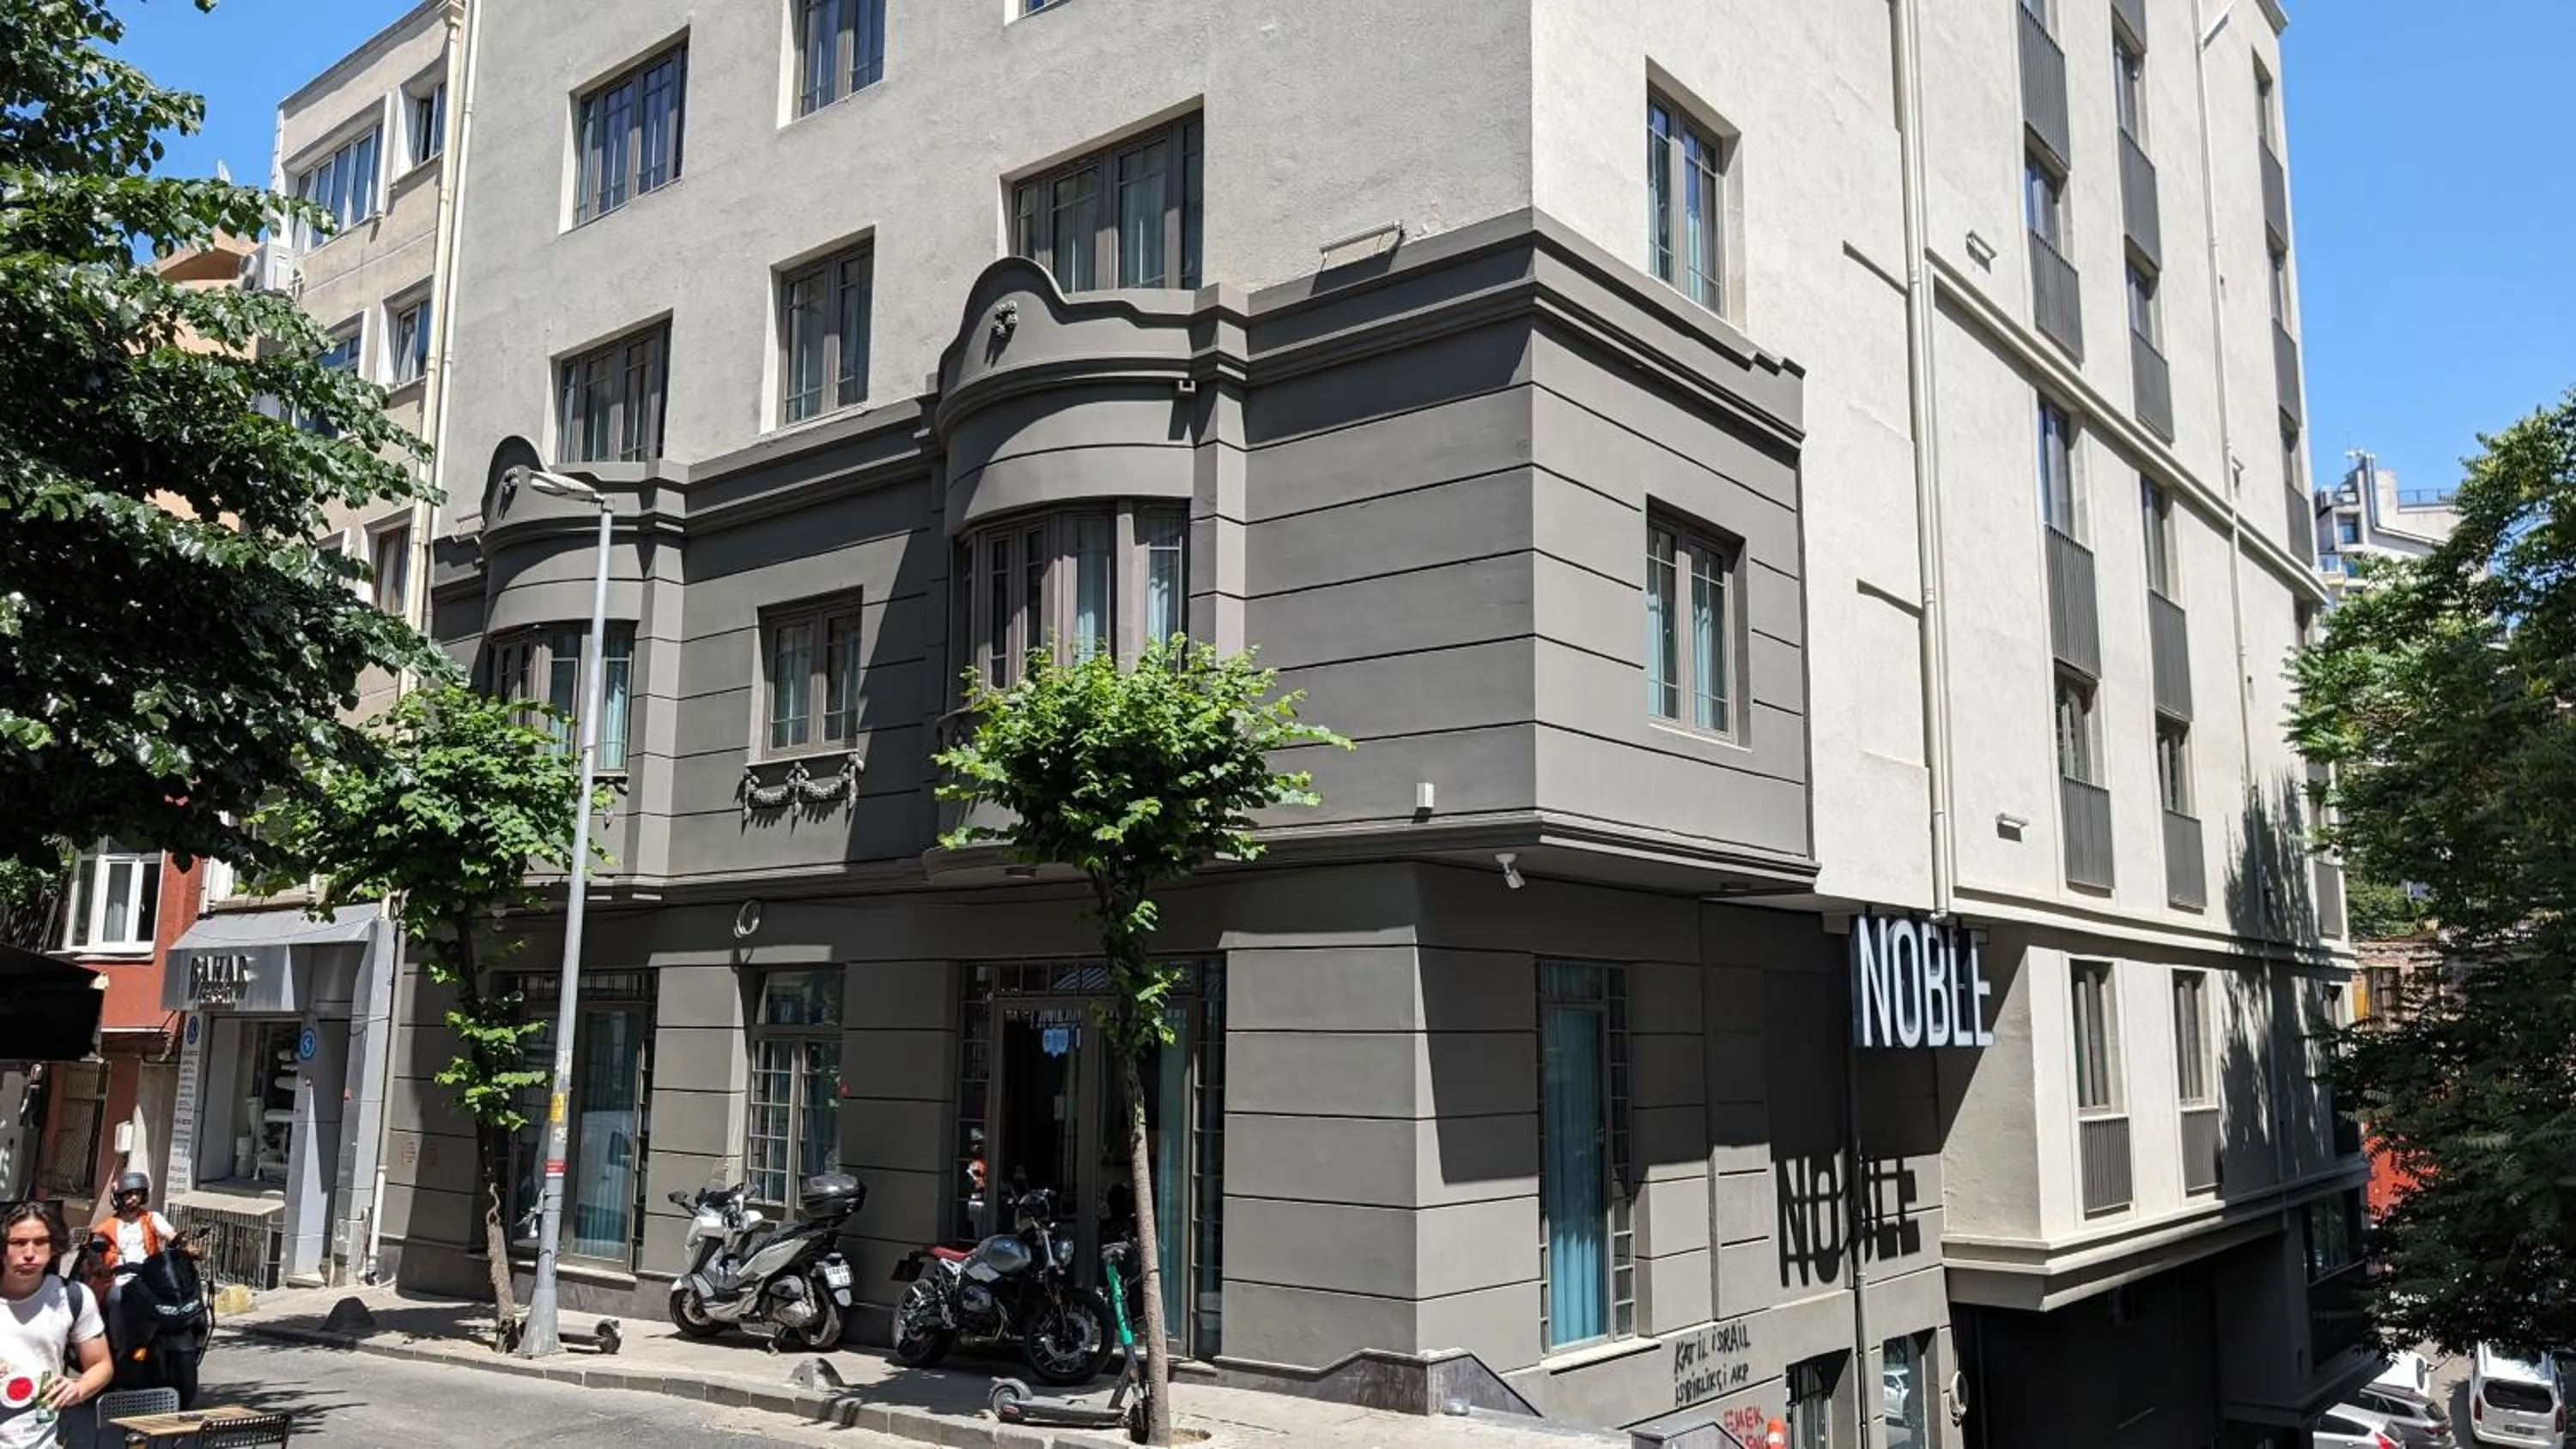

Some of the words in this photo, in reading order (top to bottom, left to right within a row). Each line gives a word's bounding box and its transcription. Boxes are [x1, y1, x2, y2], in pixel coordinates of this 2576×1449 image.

[1857, 915, 1995, 1048] NOBLE
[1711, 1319, 1751, 1354] İSRAİL
[1730, 1362, 1749, 1385] AKP
[1723, 1405, 1765, 1433] EMEK
